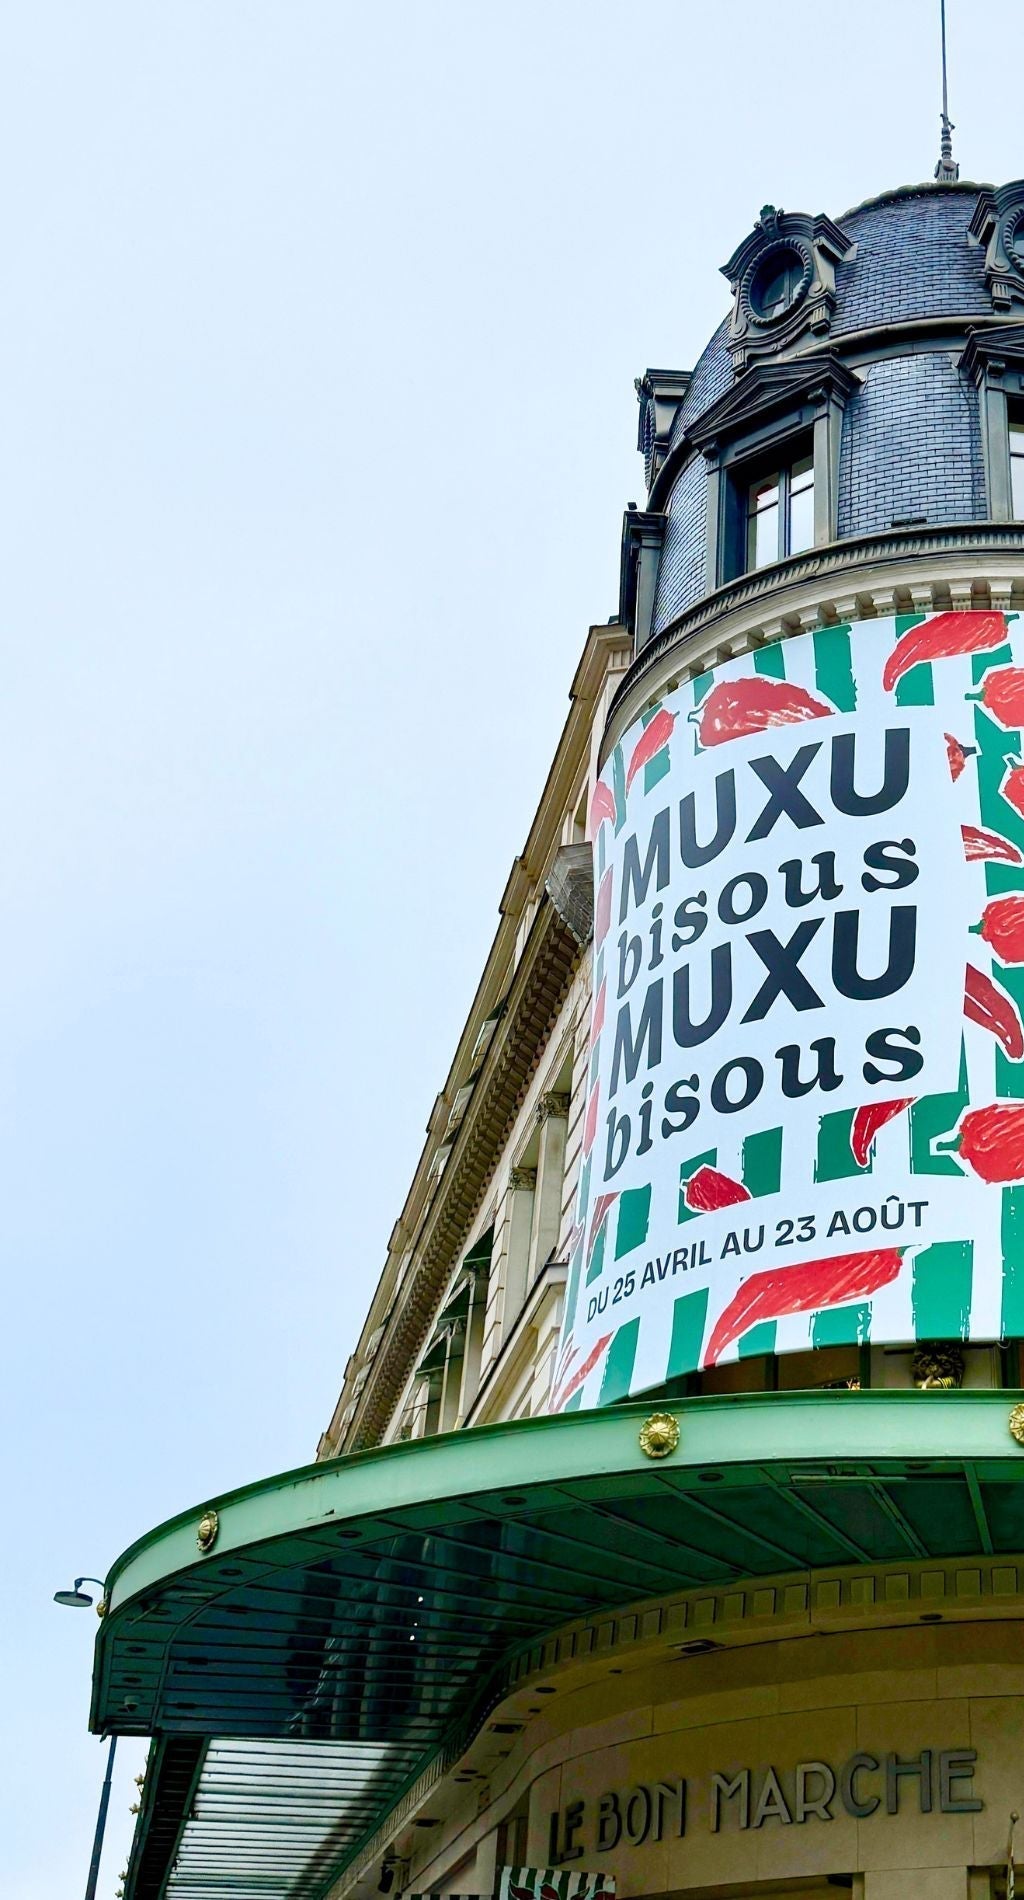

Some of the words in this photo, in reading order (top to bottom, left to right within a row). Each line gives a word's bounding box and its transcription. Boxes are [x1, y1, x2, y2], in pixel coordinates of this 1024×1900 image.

[618, 727, 911, 926] MUXU
[616, 838, 920, 1000] bisous
[608, 904, 918, 1100] MUXU
[603, 1025, 925, 1183] bisous
[586, 1290, 610, 1324] DU
[612, 1270, 637, 1305] 25
[639, 1240, 713, 1290] AVRIL
[719, 1224, 765, 1260] AU
[774, 1215, 816, 1247] 23
[826, 1195, 930, 1238] AOÛT
[548, 1801, 585, 1866] LE
[595, 1777, 688, 1853] BON
[708, 1748, 984, 1833] MARCHE
